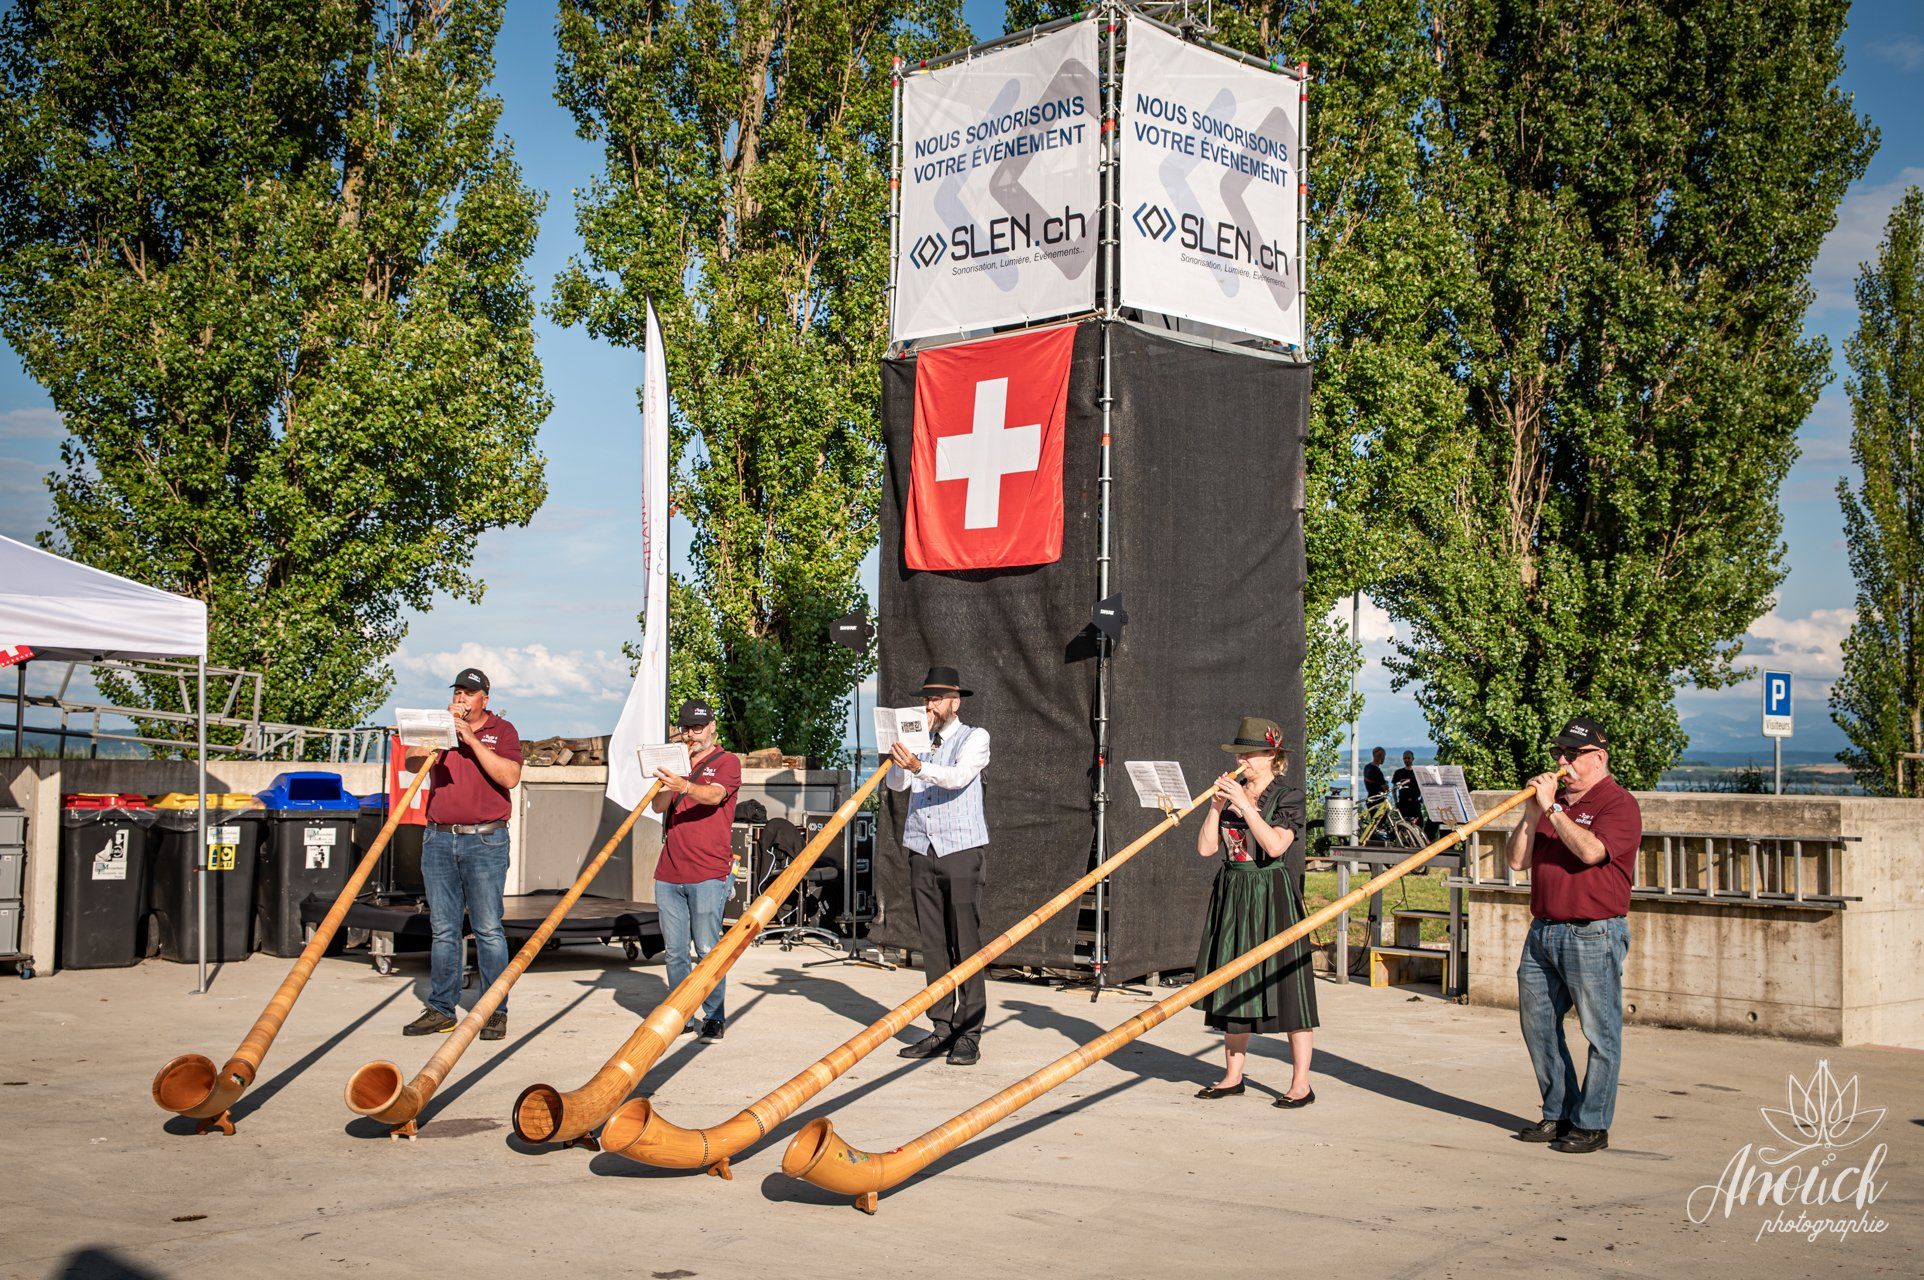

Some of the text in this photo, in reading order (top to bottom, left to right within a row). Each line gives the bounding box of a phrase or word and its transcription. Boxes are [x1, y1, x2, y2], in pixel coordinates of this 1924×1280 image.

[914, 124, 1086, 184] VOTRE ÉVÈNEMENT
[915, 96, 1085, 159] NOUS SONORISONS
[1134, 121, 1288, 187] VOTRE ÉVÈNEMENT
[1136, 93, 1288, 162] NOUS SONORISONS
[951, 205, 1086, 261] SLEN.ch
[1181, 212, 1289, 276] SLEN.ch
[952, 262, 998, 276] Sonorisation,
[1772, 679, 1785, 711] P
